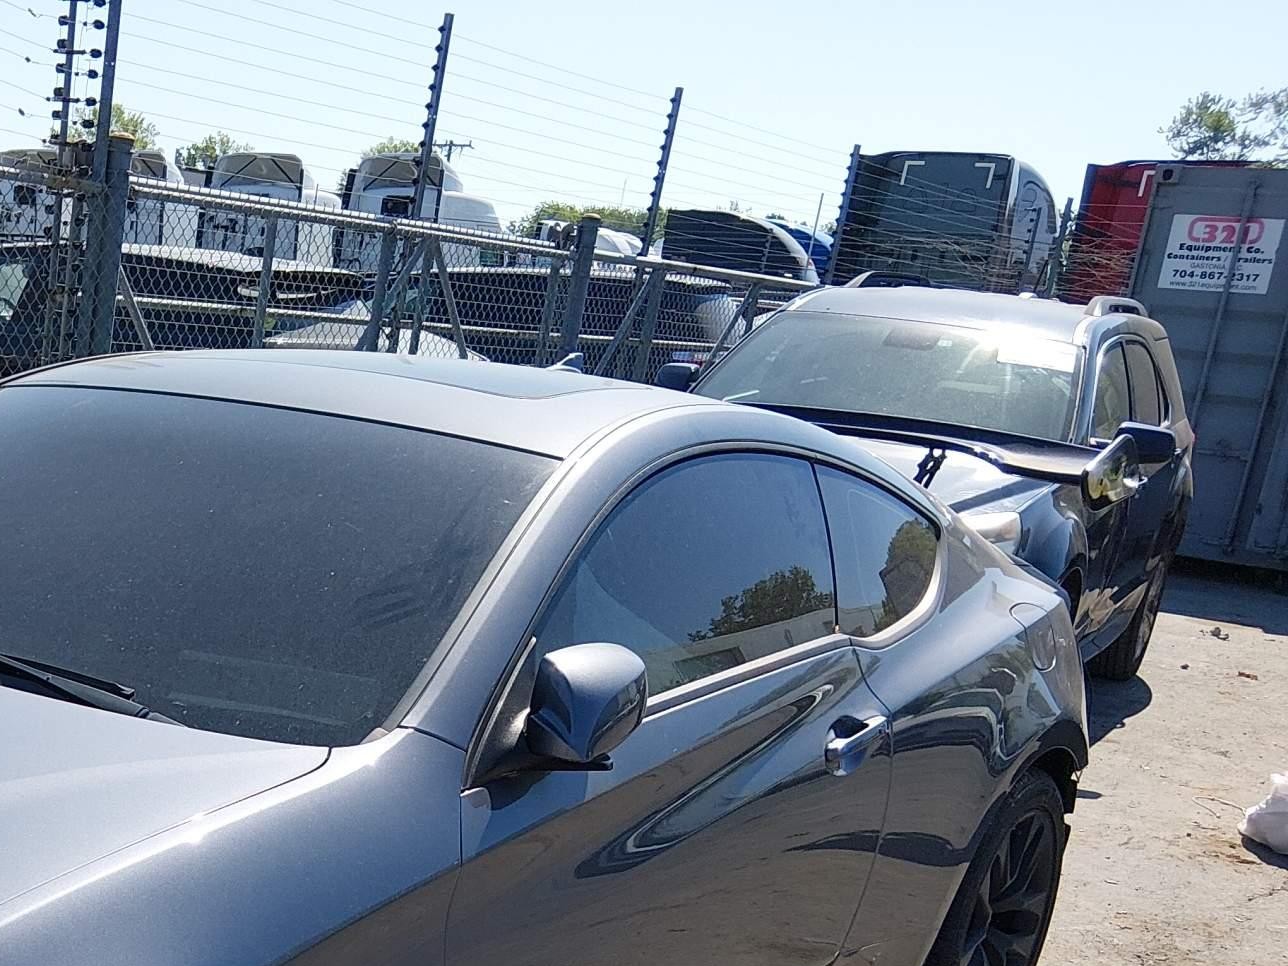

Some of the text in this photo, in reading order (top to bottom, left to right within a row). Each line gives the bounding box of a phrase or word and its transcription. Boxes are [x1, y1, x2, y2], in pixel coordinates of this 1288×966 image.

[1201, 224, 1251, 245] 321
[1246, 246, 1265, 254] Co.
[1167, 252, 1221, 261] Containers
[1236, 256, 1273, 264] railers
[1172, 269, 1260, 282] 704-867-2317
